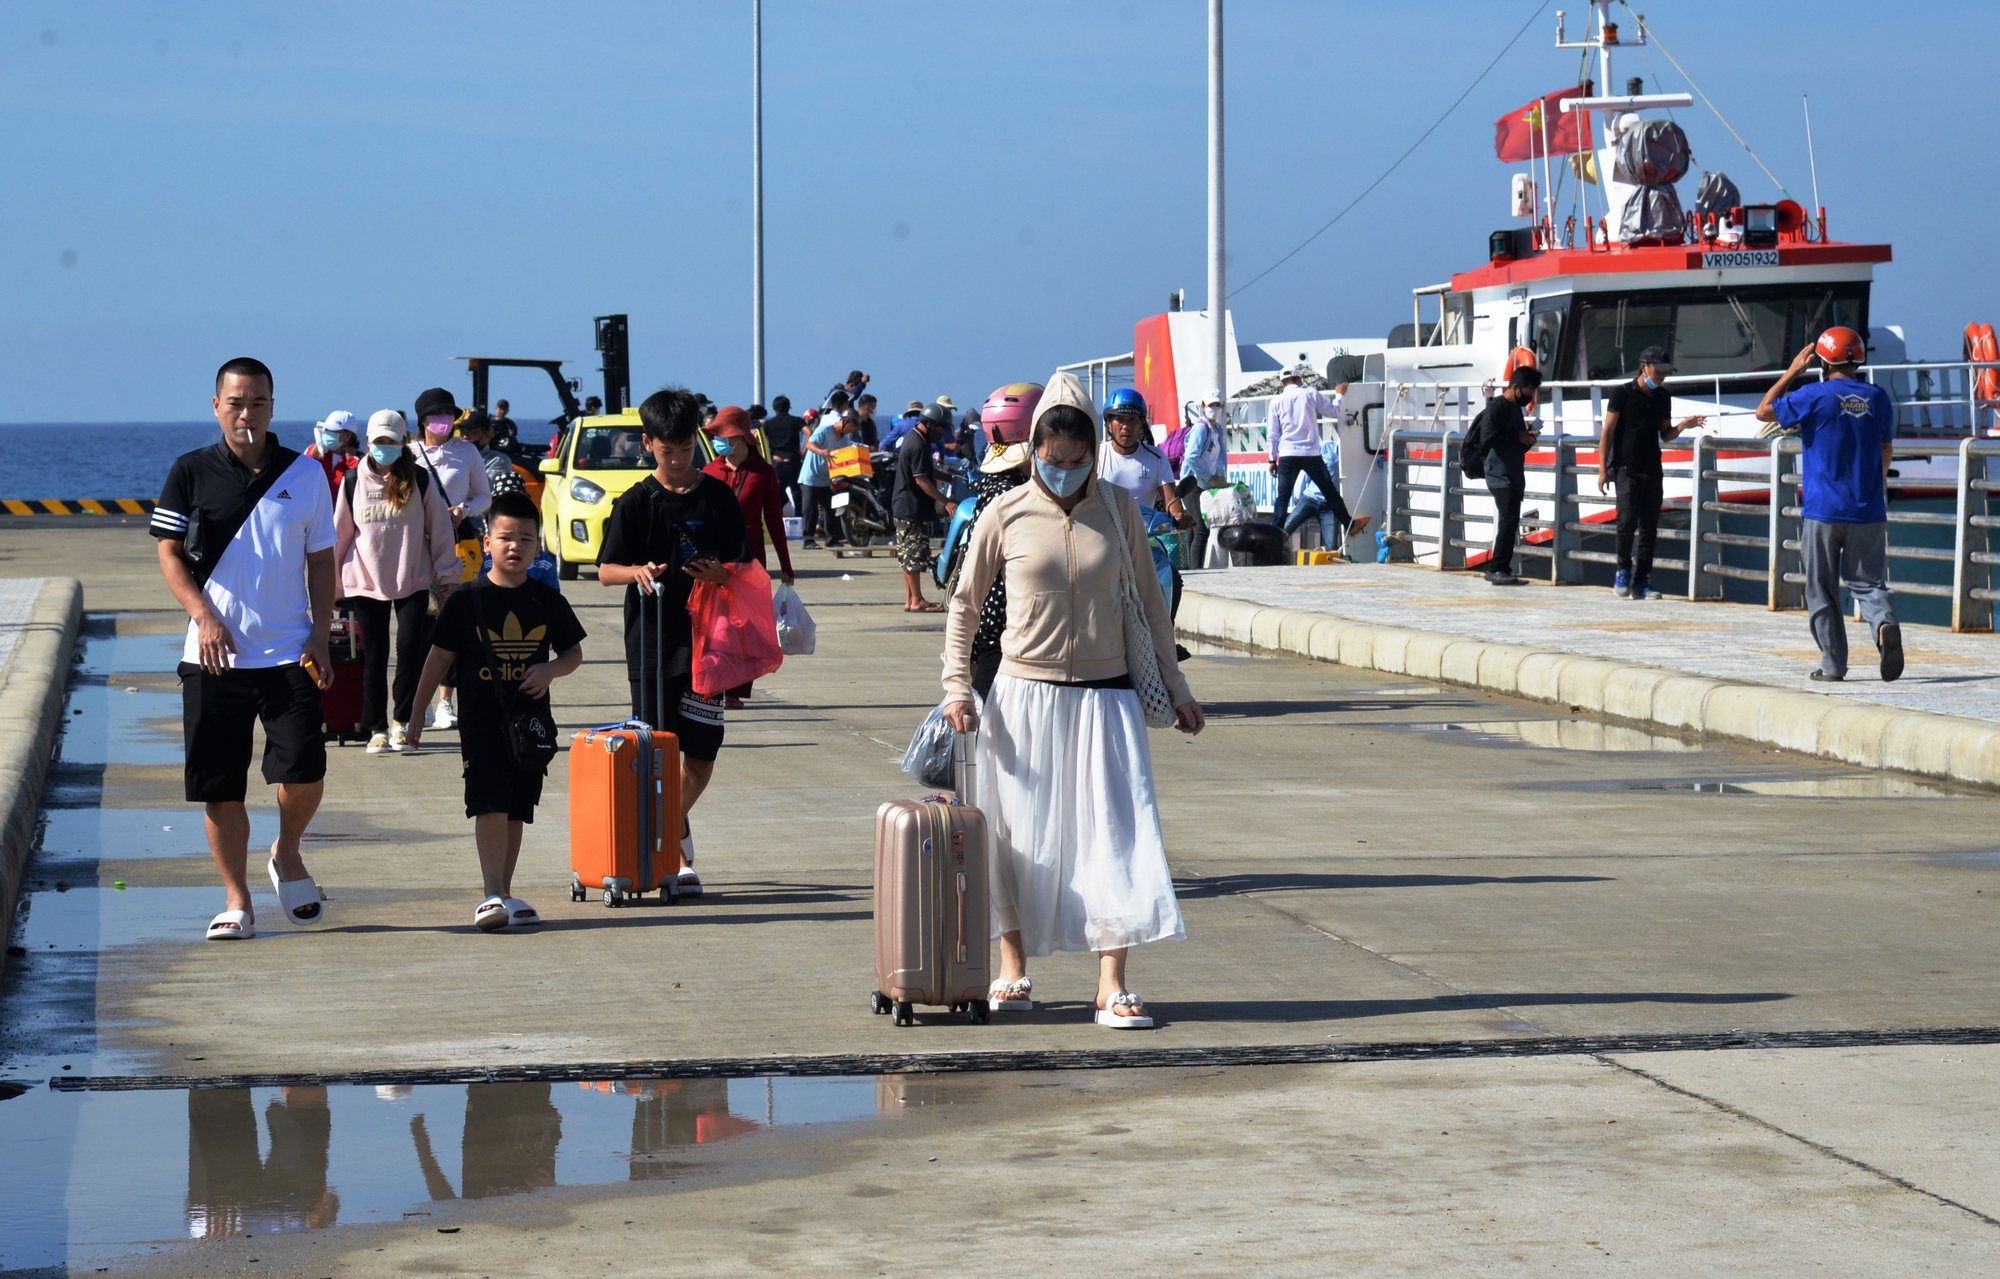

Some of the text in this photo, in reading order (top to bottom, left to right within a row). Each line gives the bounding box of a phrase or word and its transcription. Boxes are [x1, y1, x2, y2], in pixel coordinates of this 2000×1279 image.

[1704, 251, 1778, 267] VR19051932
[478, 663, 526, 681] adid
[688, 706, 716, 718] BROWNE
